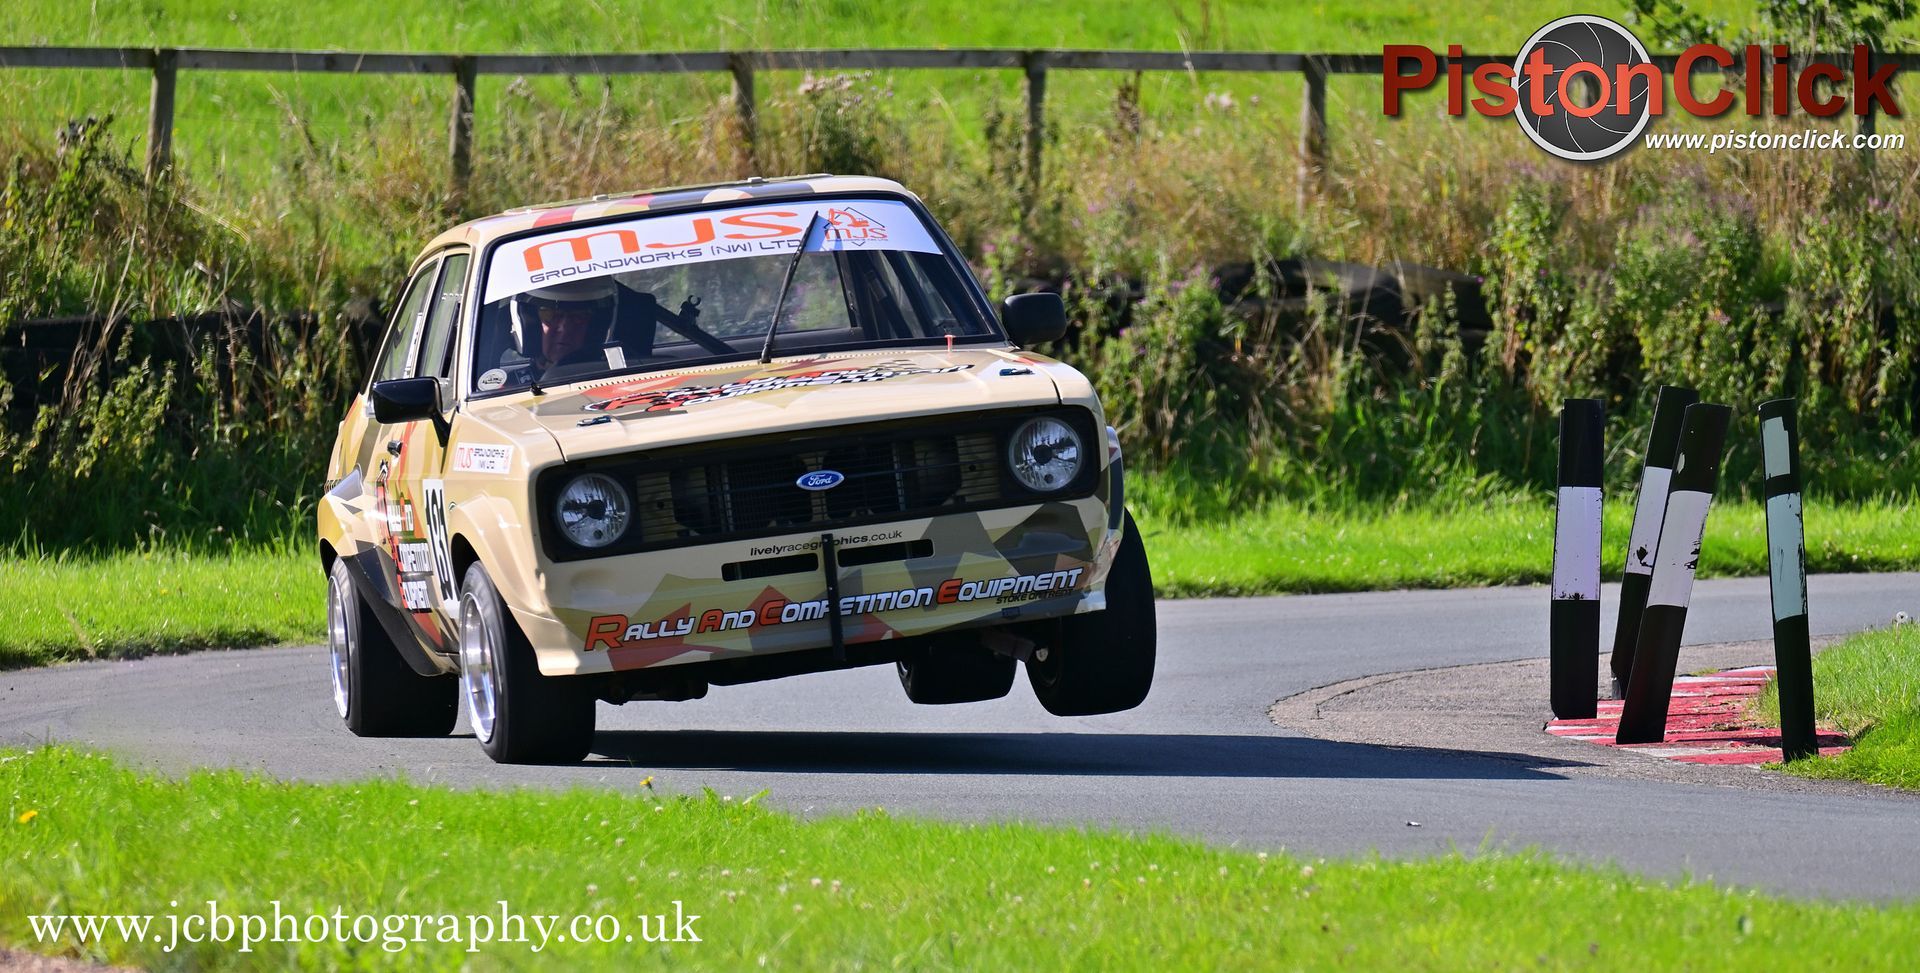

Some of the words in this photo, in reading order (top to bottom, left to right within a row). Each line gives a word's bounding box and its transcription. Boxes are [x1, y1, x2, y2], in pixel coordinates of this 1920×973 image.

[530, 248, 703, 283] GROUNDWORKS
[711, 243, 753, 256] (NW)
[759, 239, 801, 250] LTD
[807, 474, 833, 486] Ford
[750, 530, 903, 556] livelyracegrphics.co.uk
[584, 614, 696, 651] RALLY
[697, 608, 756, 634] AND
[936, 567, 1084, 604] EQUIPMENT
